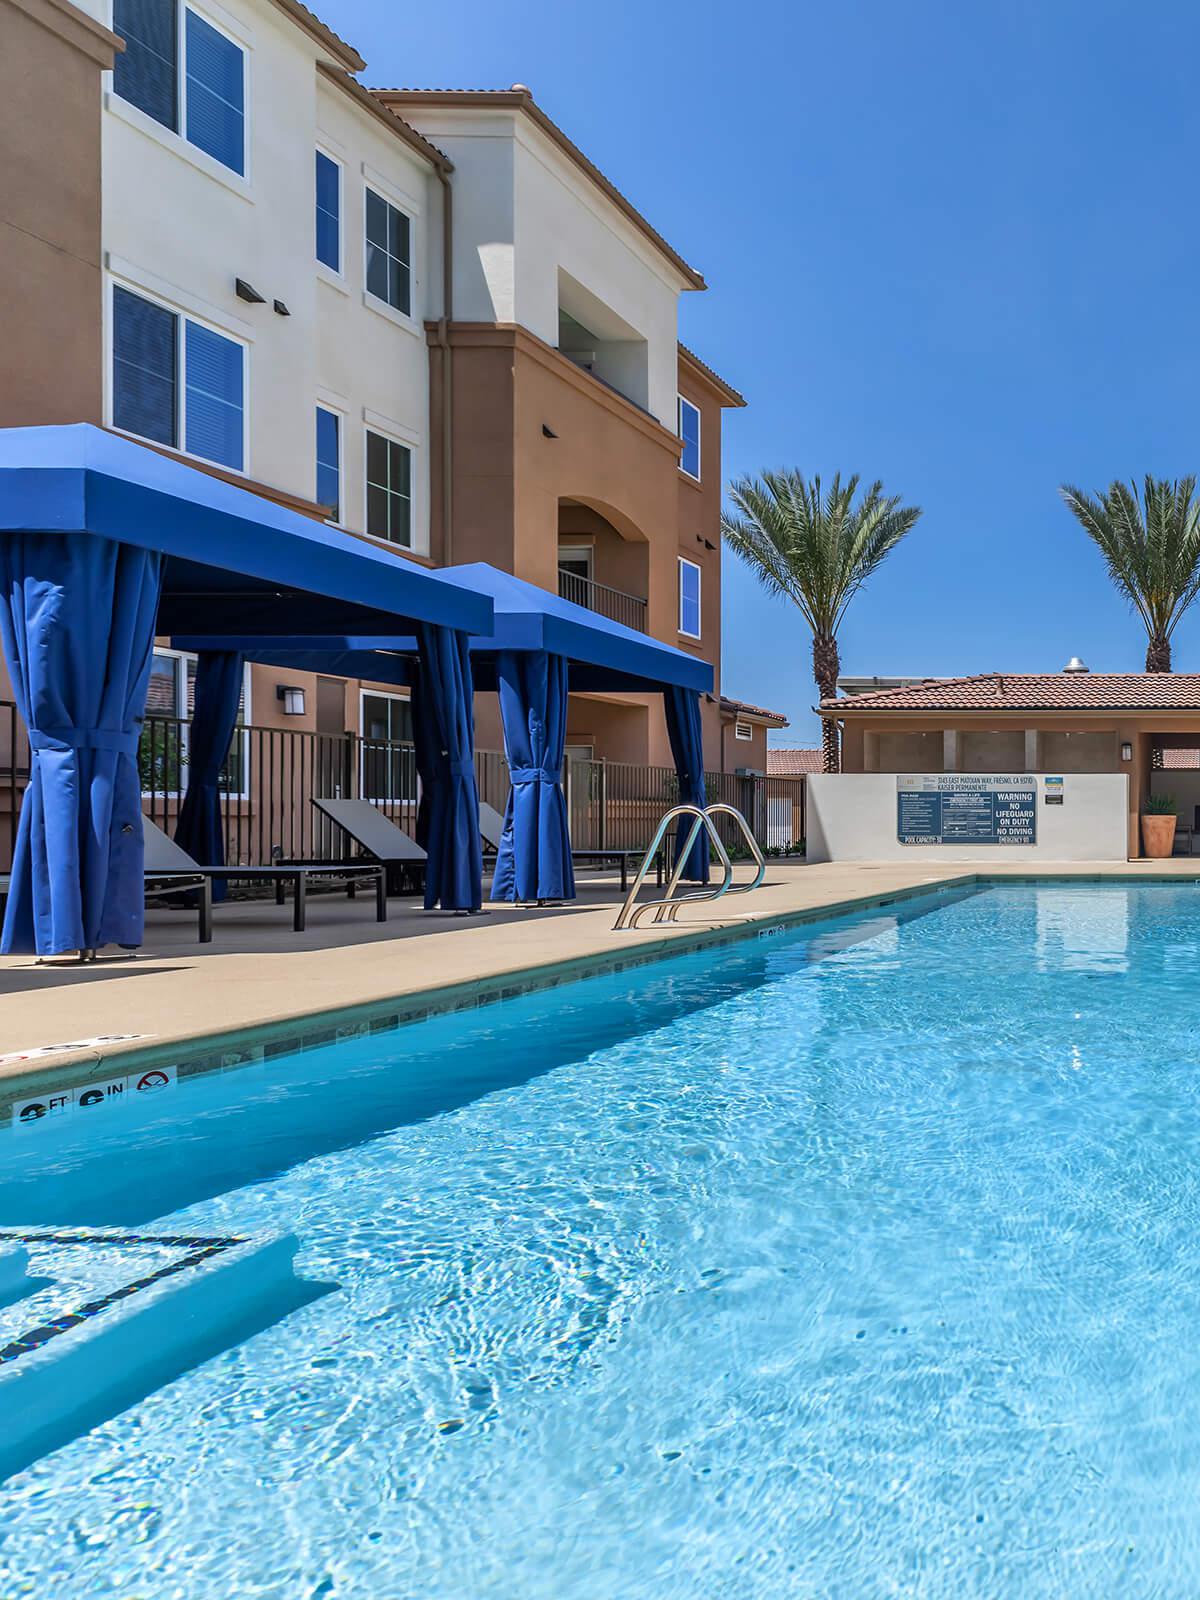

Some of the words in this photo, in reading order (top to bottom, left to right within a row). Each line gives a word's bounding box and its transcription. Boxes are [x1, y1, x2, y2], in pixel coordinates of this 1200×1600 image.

[997, 793, 1033, 801] WARNING
[995, 810, 1034, 818] LIFEGUARD
[49, 1096, 67, 1110] FT
